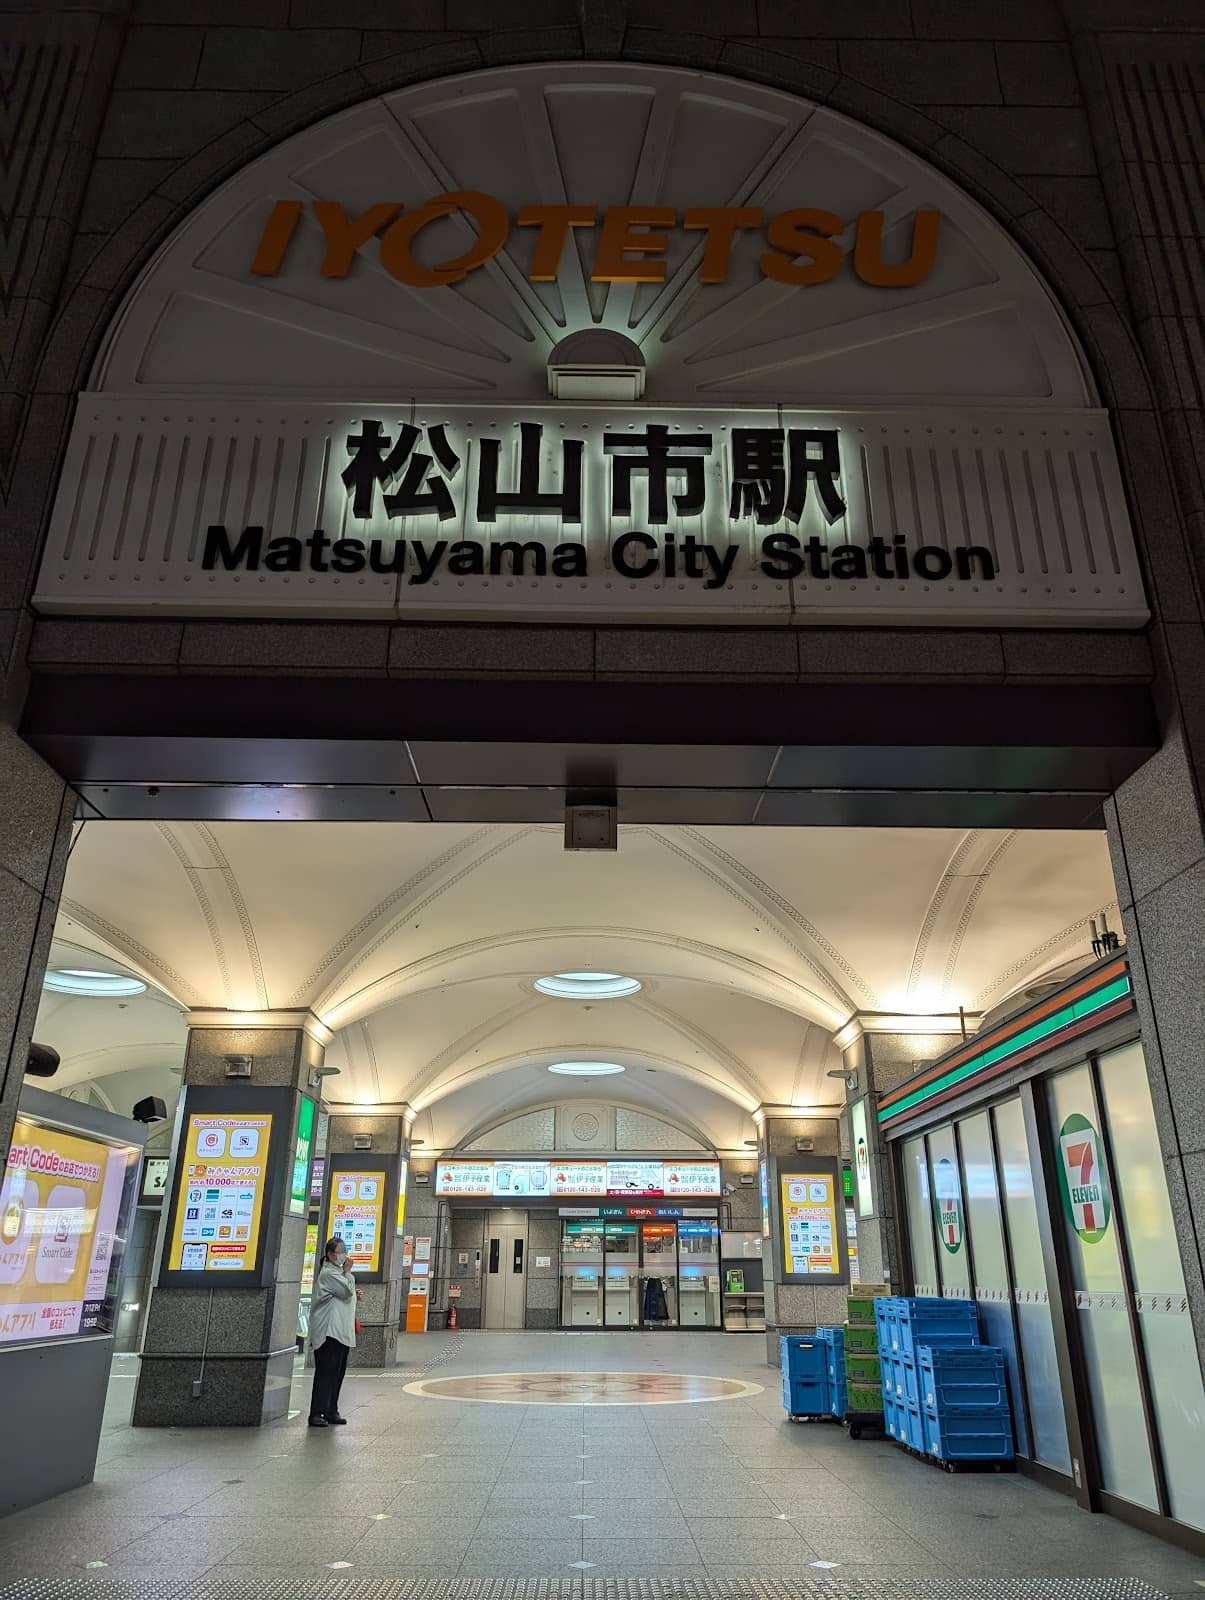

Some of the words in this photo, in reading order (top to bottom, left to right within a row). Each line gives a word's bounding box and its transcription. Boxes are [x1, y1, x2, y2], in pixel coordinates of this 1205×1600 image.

[250, 190, 941, 287] IYOTETSU
[341, 419, 847, 526] 松山市駅
[202, 525, 588, 585] Matsuyama
[611, 531, 739, 589] City
[760, 532, 995, 580] Station
[603, 1208, 623, 1216] いよぎん
[630, 1208, 652, 1216] ひめぎん
